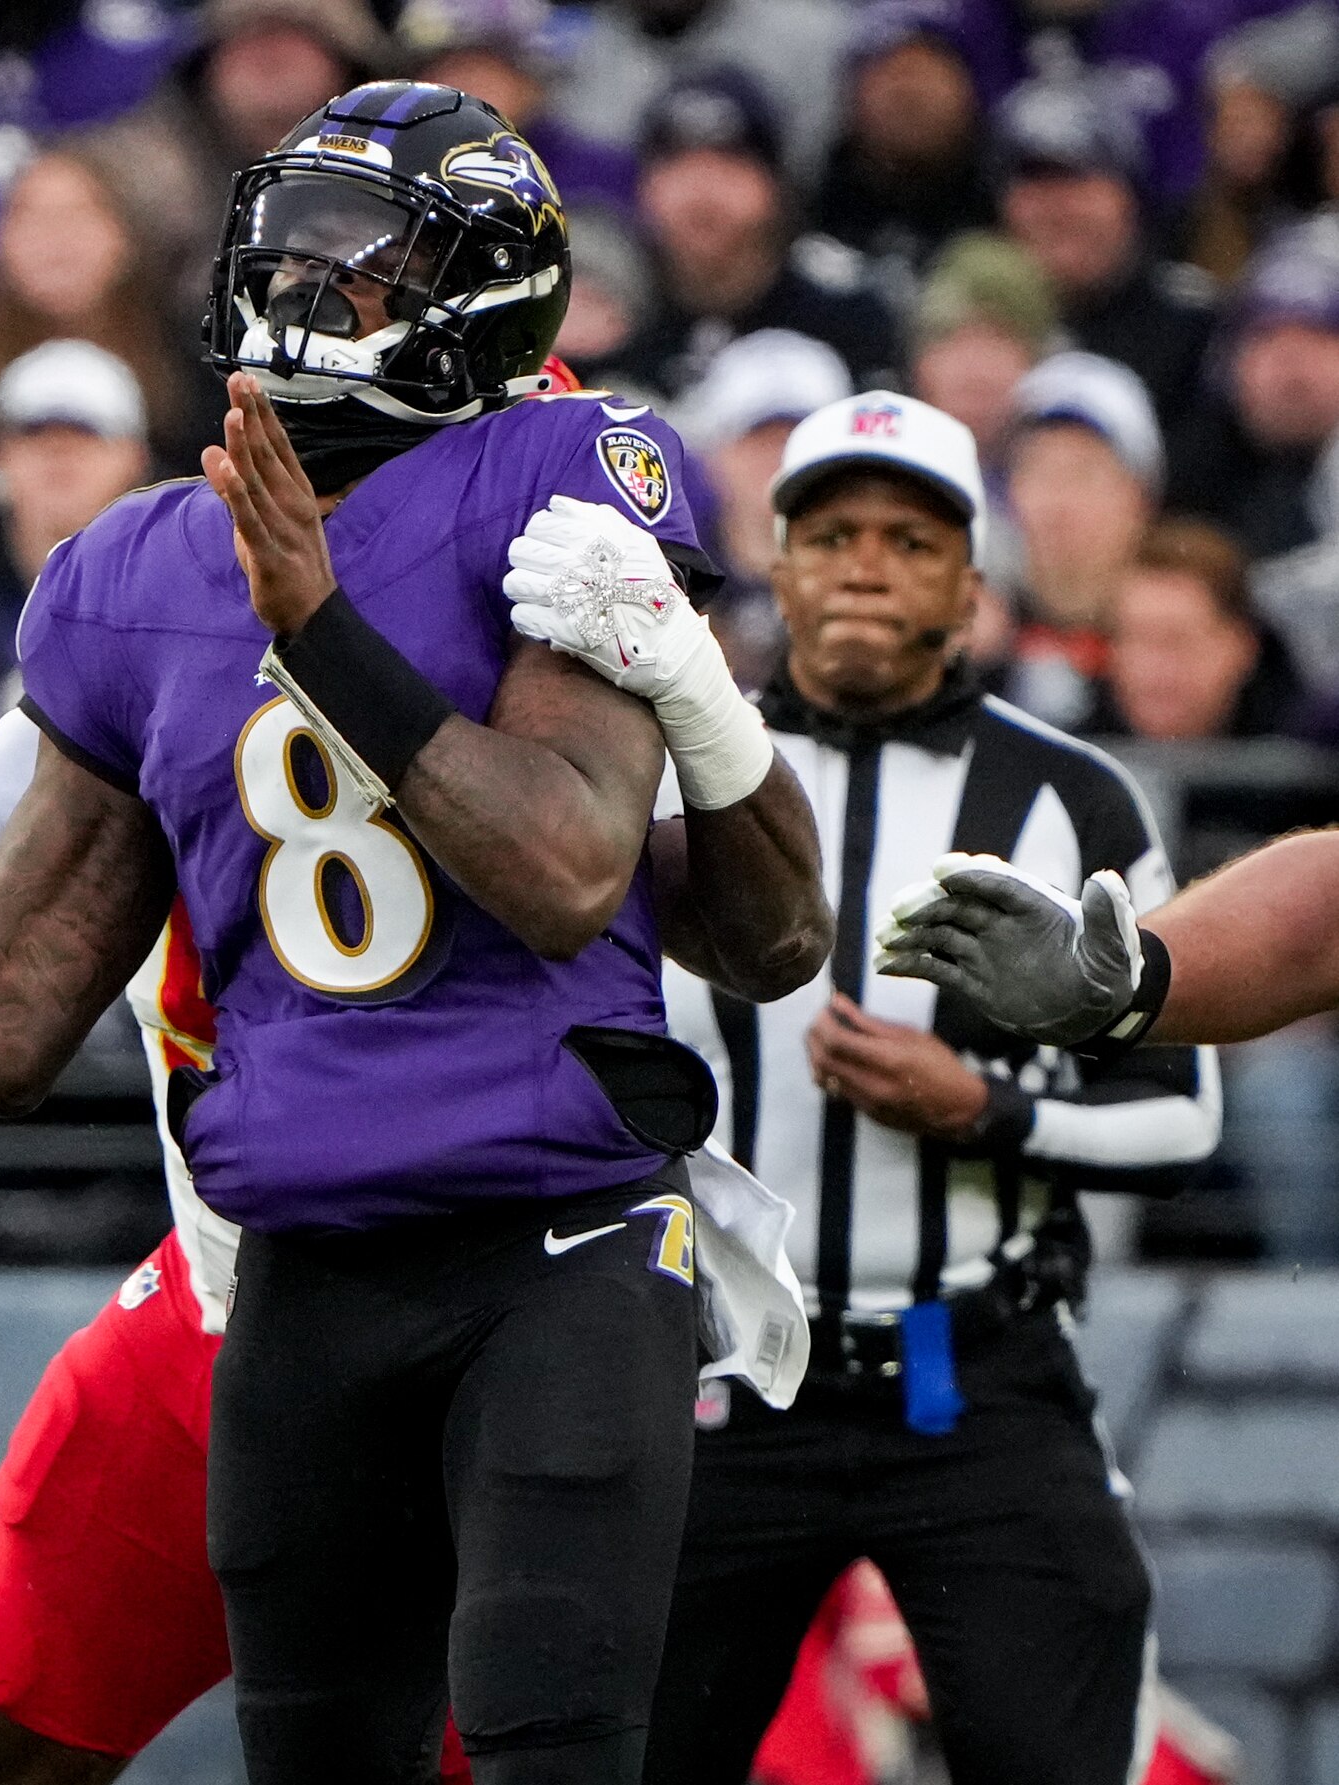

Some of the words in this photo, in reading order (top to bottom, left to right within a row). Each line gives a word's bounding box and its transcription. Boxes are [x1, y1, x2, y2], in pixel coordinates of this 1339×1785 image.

[317, 135, 369, 155] RAVENS
[605, 435, 657, 457] RAVENS
[233, 693, 435, 993] 8
